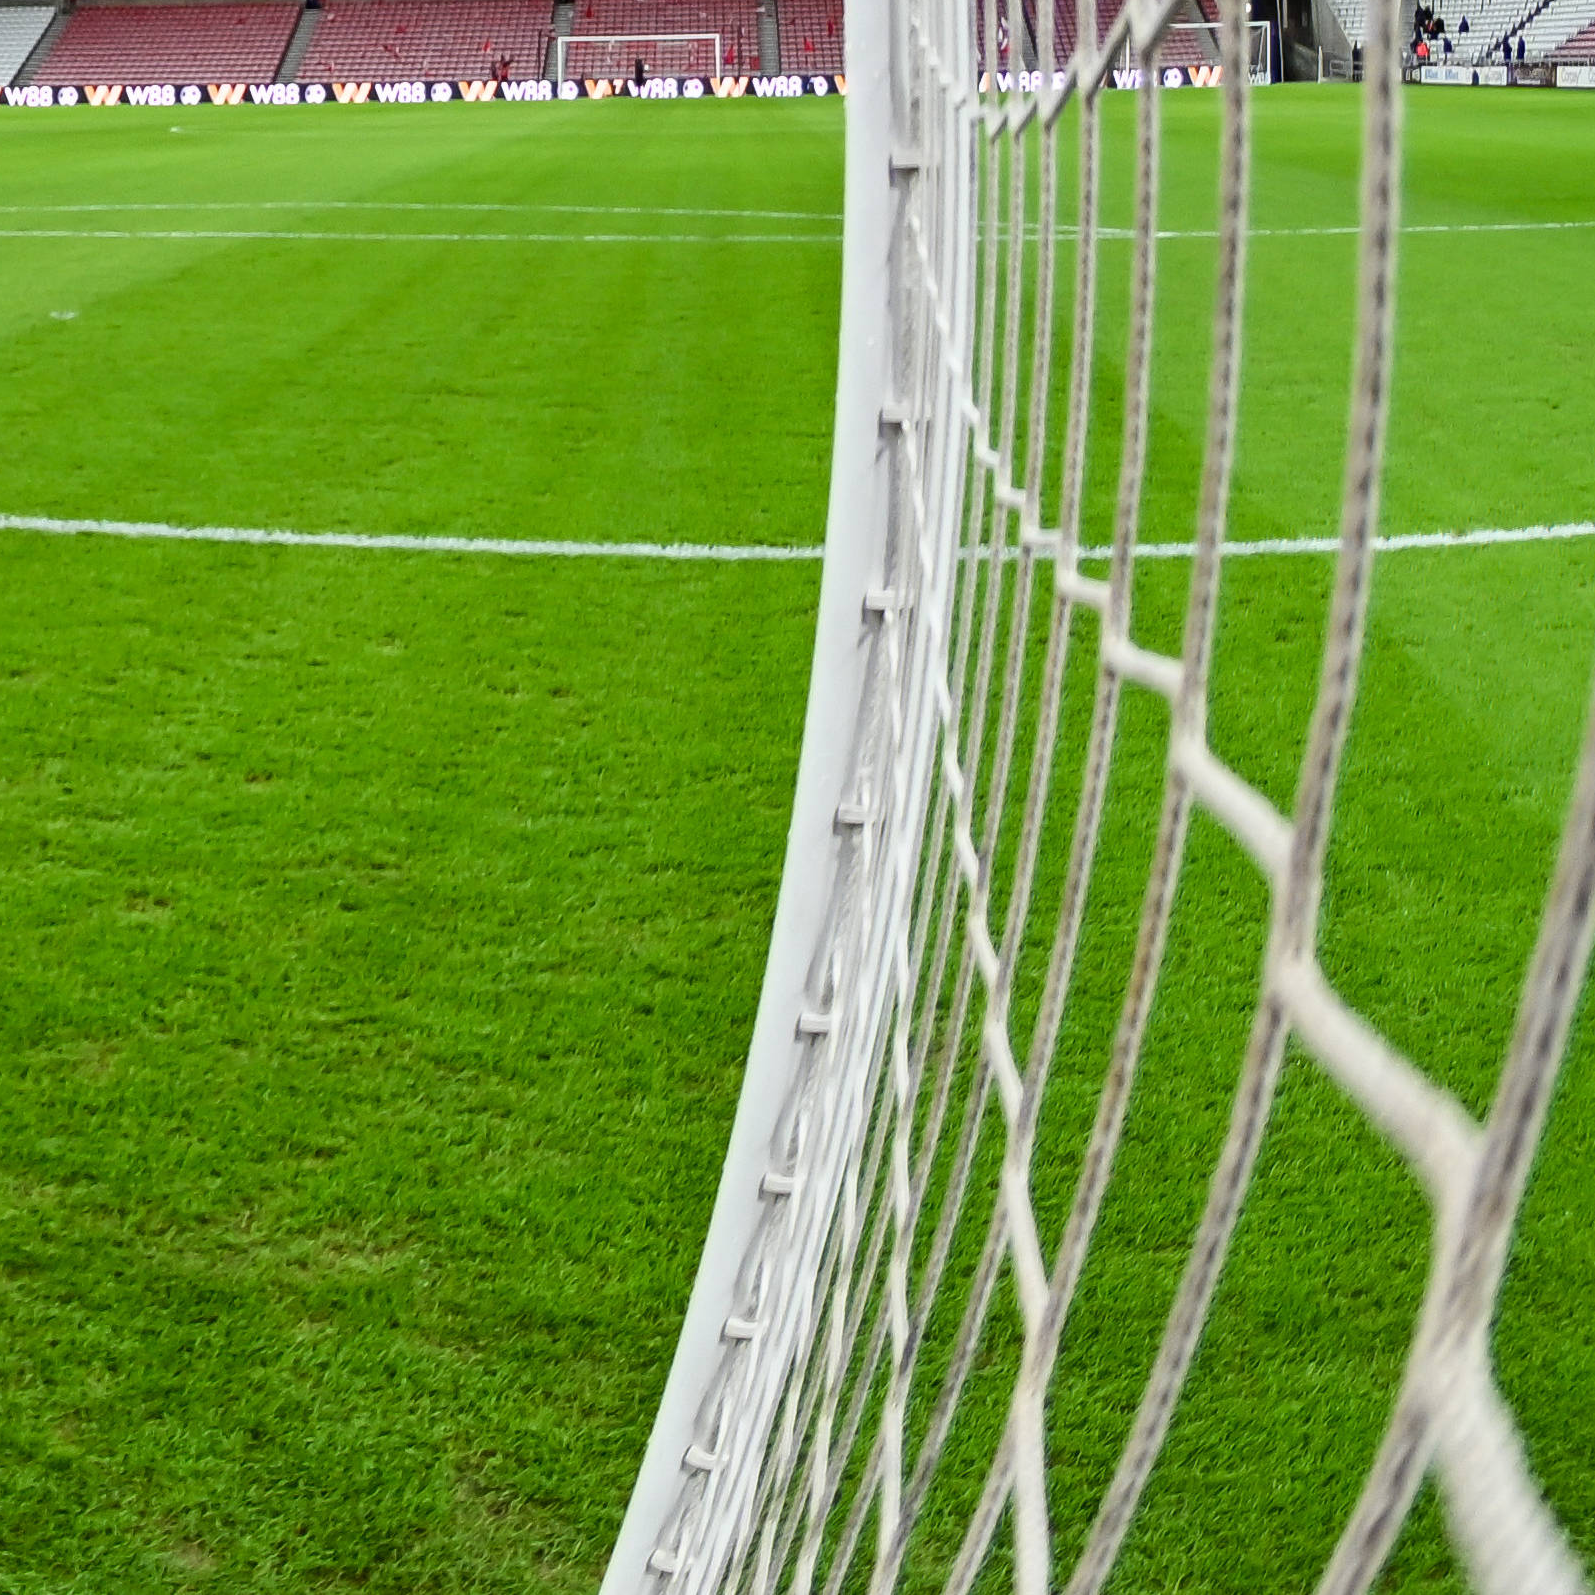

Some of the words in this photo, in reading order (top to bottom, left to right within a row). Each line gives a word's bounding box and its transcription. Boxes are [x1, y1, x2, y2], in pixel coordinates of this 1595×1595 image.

[4, 86, 53, 108] W88
[125, 84, 176, 107] W88
[249, 83, 300, 106] W88
[374, 82, 426, 104] W88
